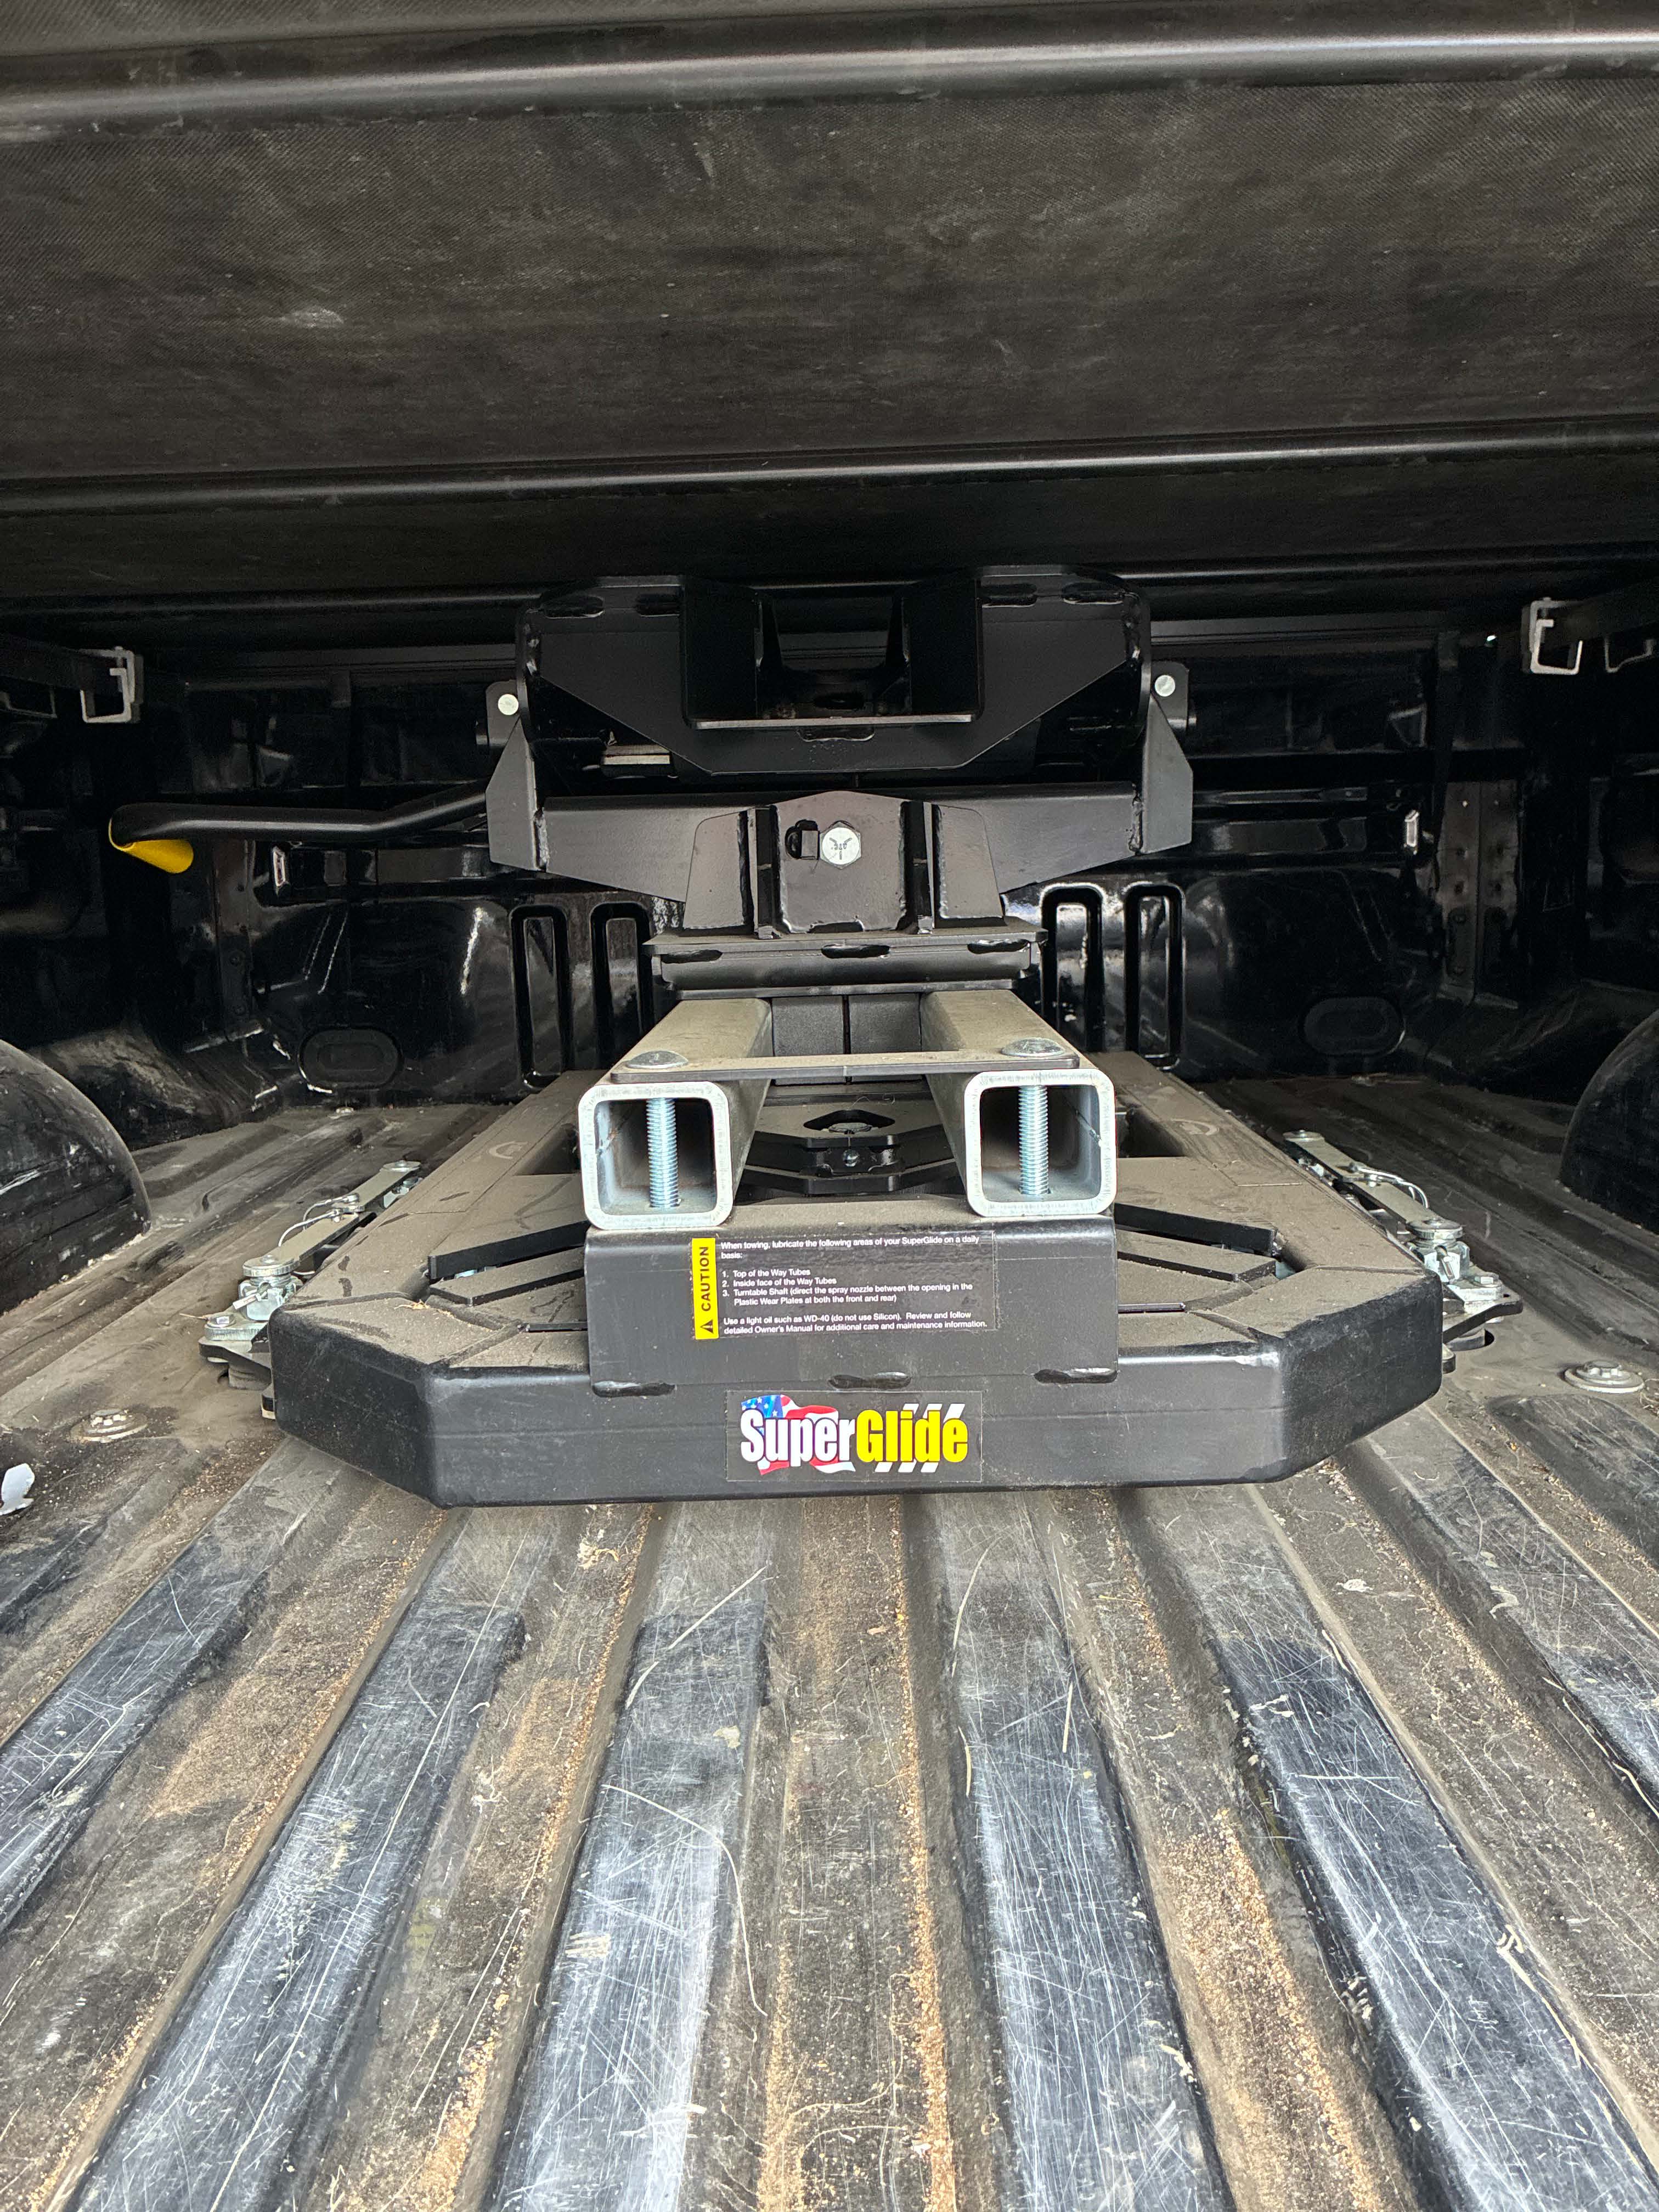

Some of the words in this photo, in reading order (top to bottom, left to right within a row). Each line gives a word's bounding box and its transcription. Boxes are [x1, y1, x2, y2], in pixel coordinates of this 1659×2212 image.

[720, 1241, 742, 1249] When
[743, 1240, 770, 1250] towing,
[772, 1240, 804, 1248] lubricate
[819, 1239, 851, 1249] following
[884, 1239, 900, 1247] your
[902, 1237, 943, 1246] SuperGlide
[962, 1235, 979, 1245] daily
[721, 1251, 743, 1259] basis:
[699, 1246, 711, 1311] CAUTION
[732, 1269, 747, 1279] Top
[770, 1269, 787, 1278] Way
[788, 1268, 811, 1276] Tubes
[797, 1277, 813, 1287] Way
[814, 1277, 837, 1285] Tubes
[733, 1288, 768, 1296] Turntable
[769, 1287, 788, 1295] Shaft
[789, 1286, 812, 1296] (direct
[828, 1287, 848, 1295] spray
[850, 1285, 873, 1293] nozzle
[874, 1284, 906, 1293] between
[921, 1283, 951, 1293] opening
[734, 1297, 759, 1305] Plastic
[760, 1296, 779, 1305] Wear
[781, 1296, 804, 1304] Plates
[881, 1294, 898, 1302] rear)
[746, 1316, 762, 1326] light
[831, 1314, 843, 1323] (do
[873, 1313, 901, 1322] Silicon).
[906, 1312, 932, 1320] Review
[950, 1311, 971, 1319] follow
[724, 1326, 753, 1334] detailed
[786, 1324, 812, 1333] Manual
[826, 1323, 861, 1331] additional
[896, 1322, 943, 1330] maintenance
[944, 1320, 987, 1329] information.
[741, 1408, 968, 1467] SuperGlide
